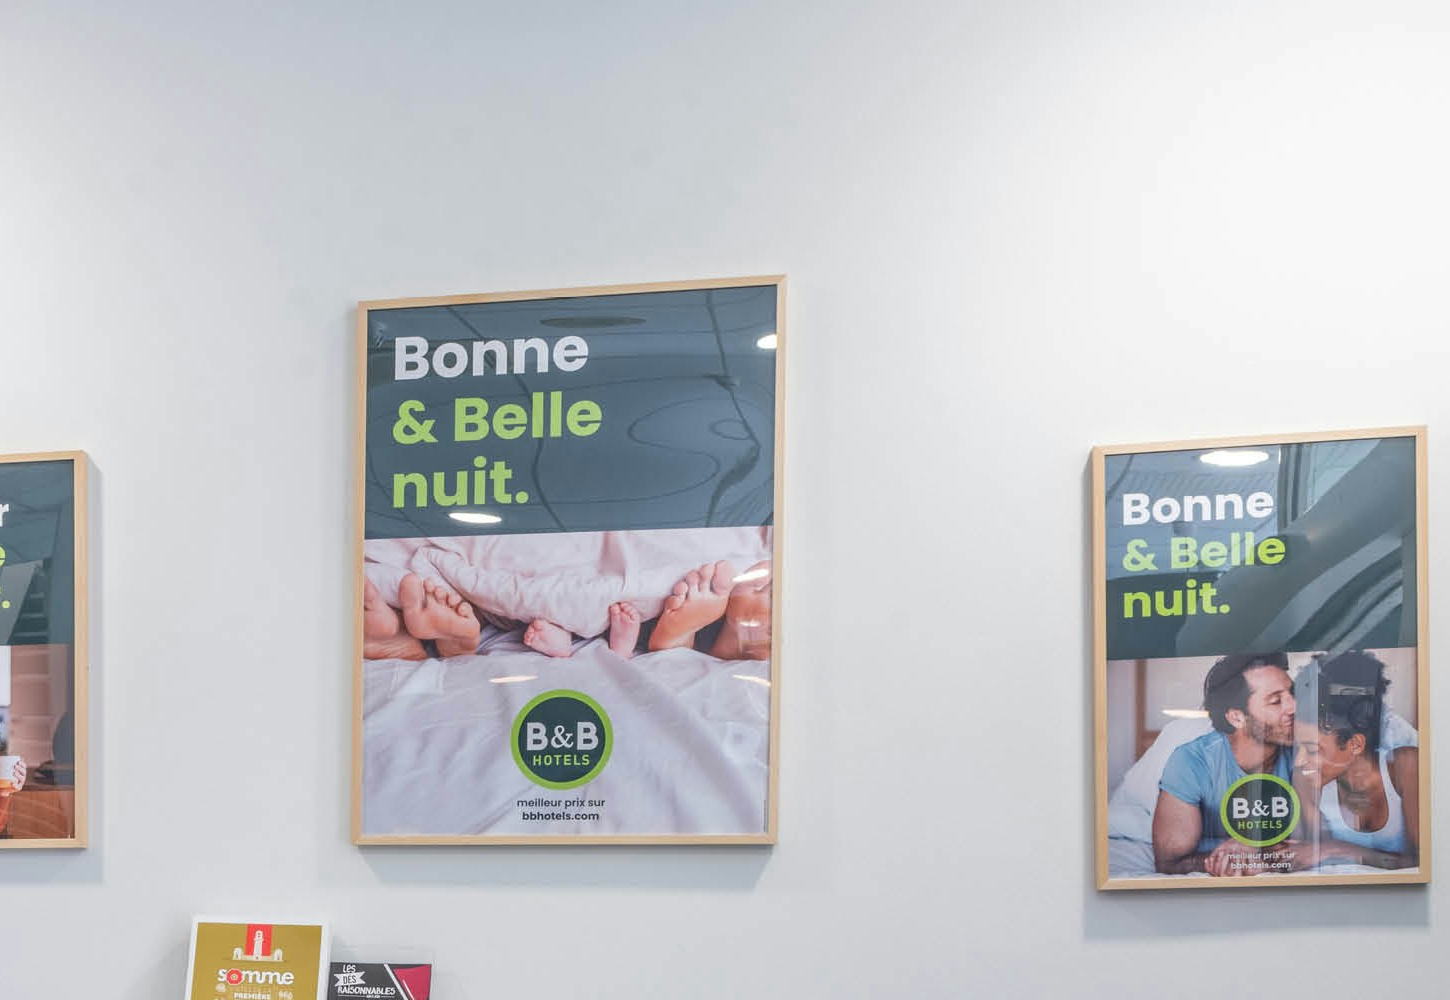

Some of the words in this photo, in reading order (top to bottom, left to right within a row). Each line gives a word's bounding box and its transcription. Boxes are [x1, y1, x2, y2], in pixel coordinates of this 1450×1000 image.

[393, 335, 589, 381] Bonne
[393, 399, 438, 444] &
[454, 391, 602, 442] Belle
[393, 455, 529, 509] nuit.
[1122, 490, 1274, 526] Bonne
[1123, 539, 1158, 572] &
[1171, 532, 1286, 568] Belle
[1124, 579, 1230, 618] nuit.
[526, 721, 598, 751] B&B
[533, 754, 590, 766] HOTELS
[517, 797, 562, 808] meilleur
[565, 797, 585, 811] prix
[588, 799, 605, 808] sur
[522, 810, 600, 822] bbhotels.com
[1233, 797, 1289, 819] B&B
[1238, 820, 1282, 830] HOTELS
[1263, 852, 1279, 862] prix
[337, 987, 395, 995] RAISONNABLES
